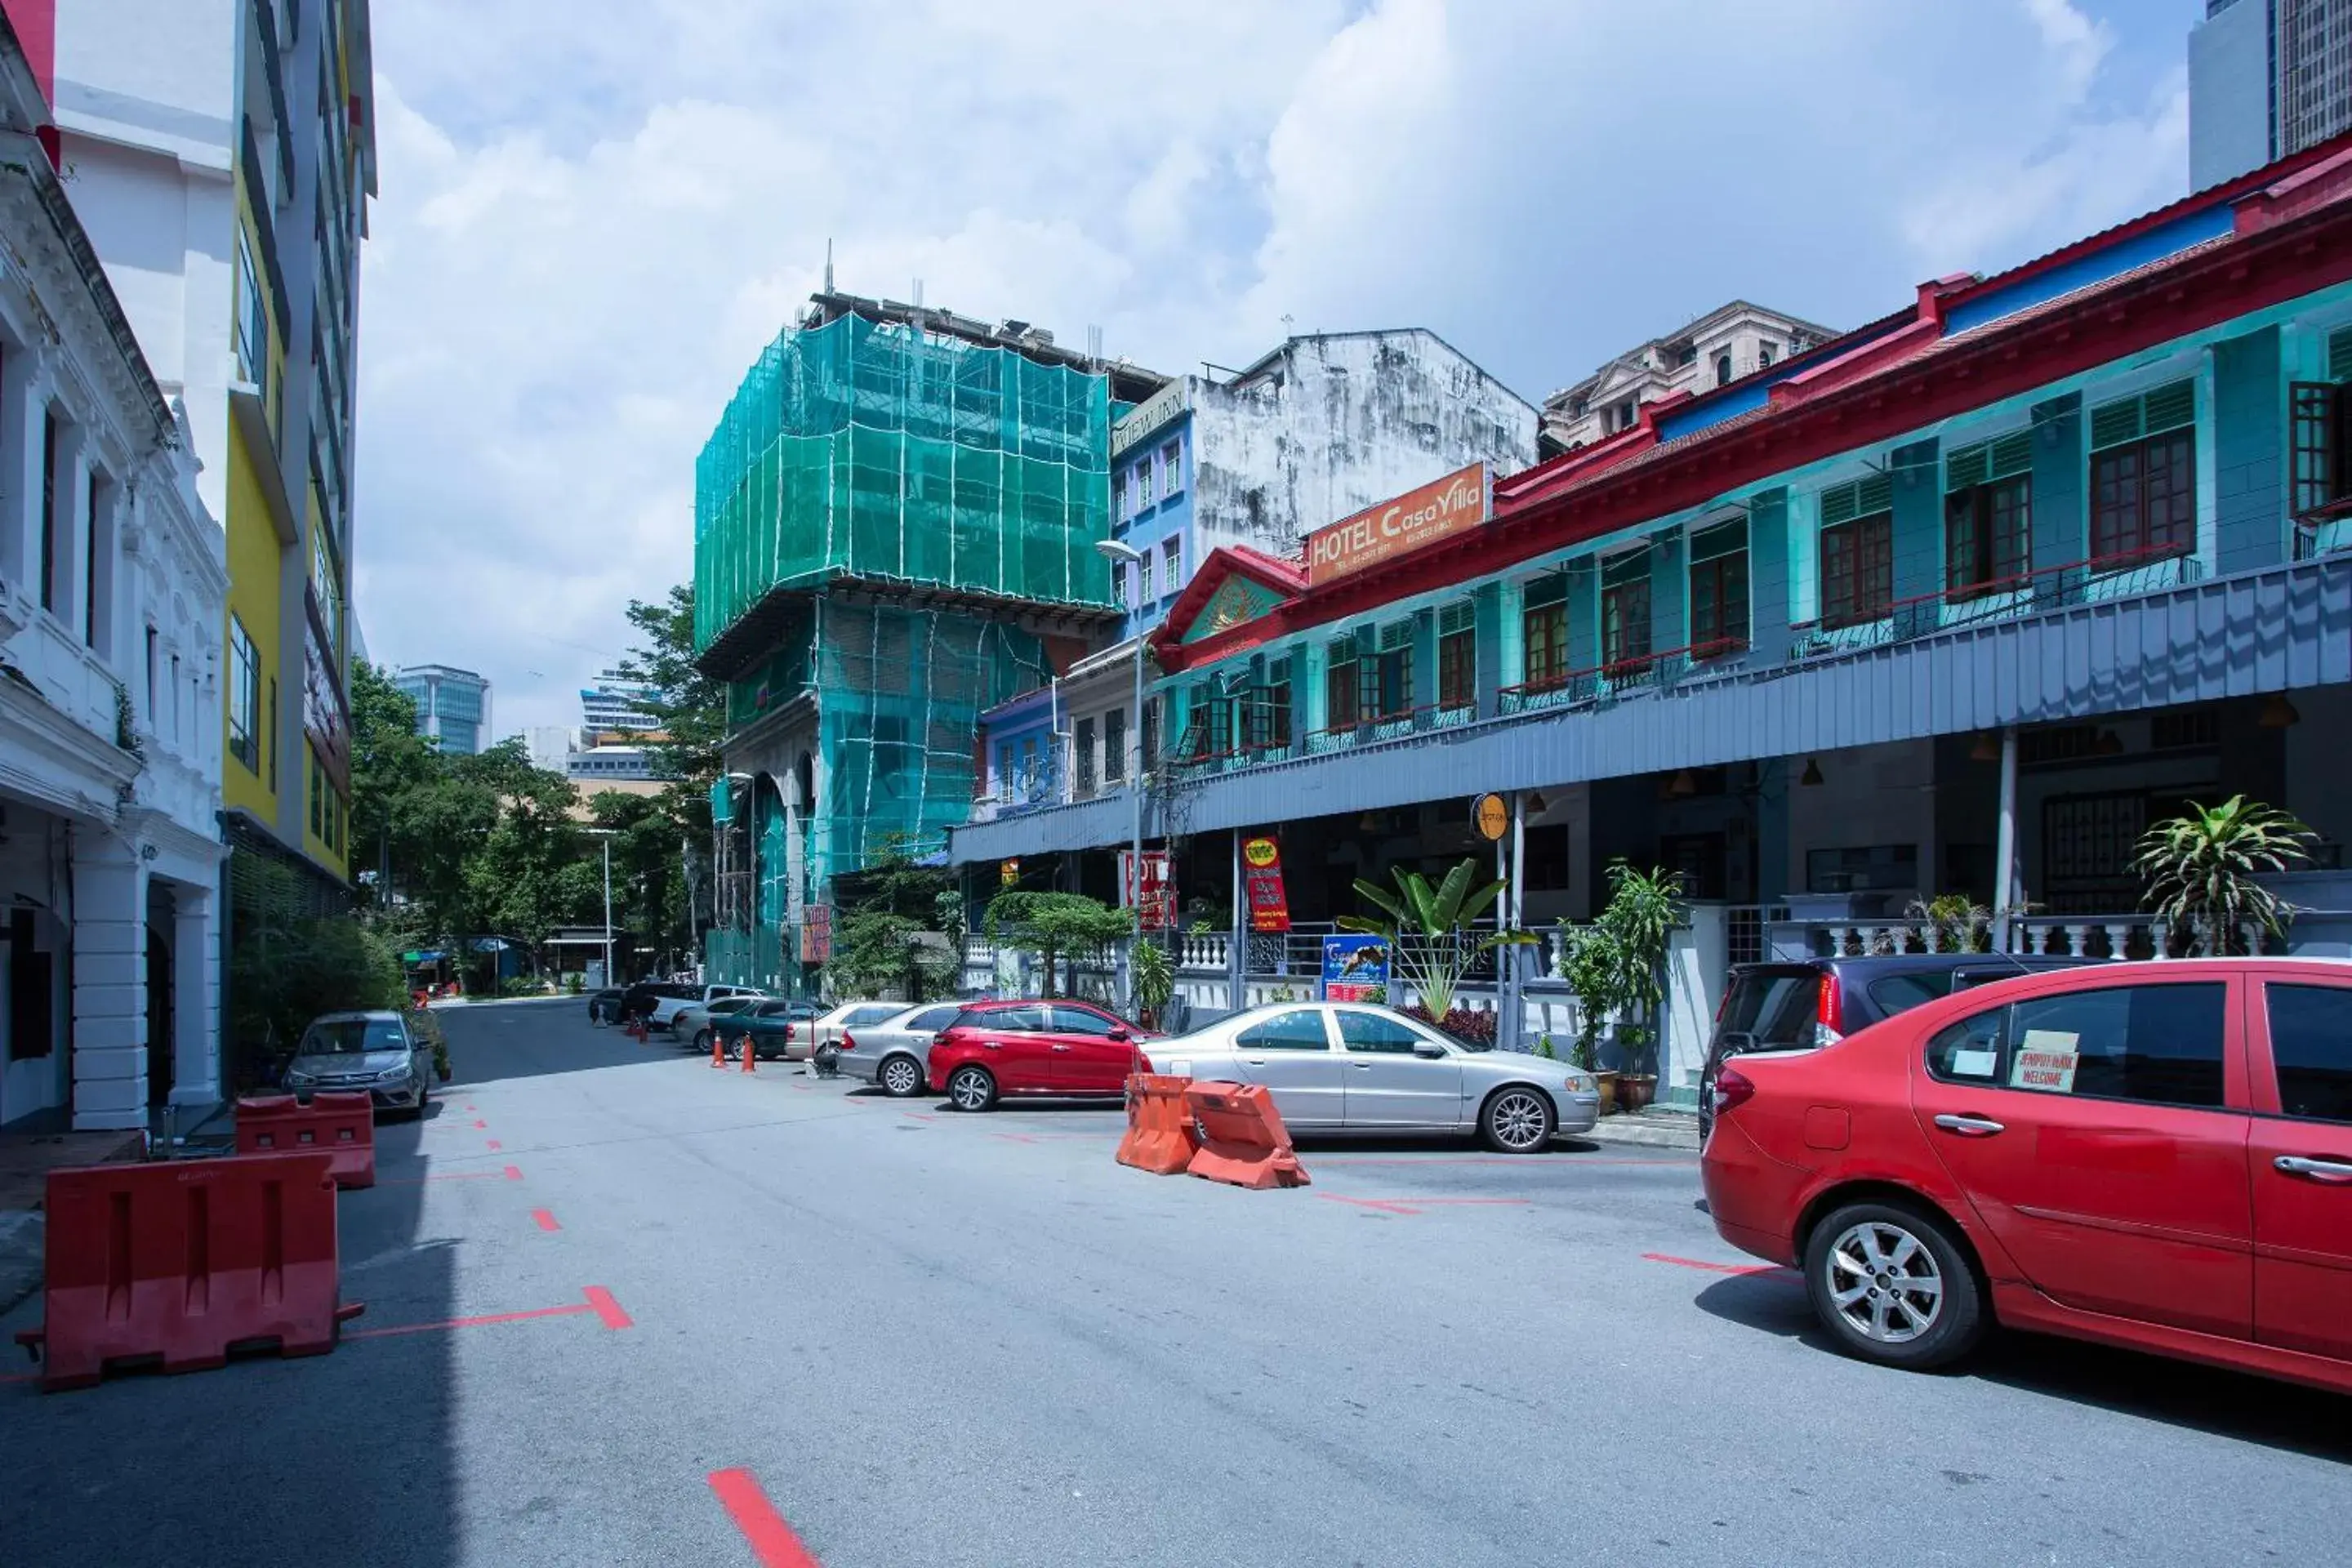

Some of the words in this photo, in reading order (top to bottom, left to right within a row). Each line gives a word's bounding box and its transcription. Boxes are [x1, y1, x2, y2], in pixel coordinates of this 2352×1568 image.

[1313, 518, 1378, 567] HOTEL
[1381, 506, 1437, 538] Casa
[1437, 478, 1480, 515] Villa
[2023, 1070, 2061, 1085] WELCOME
